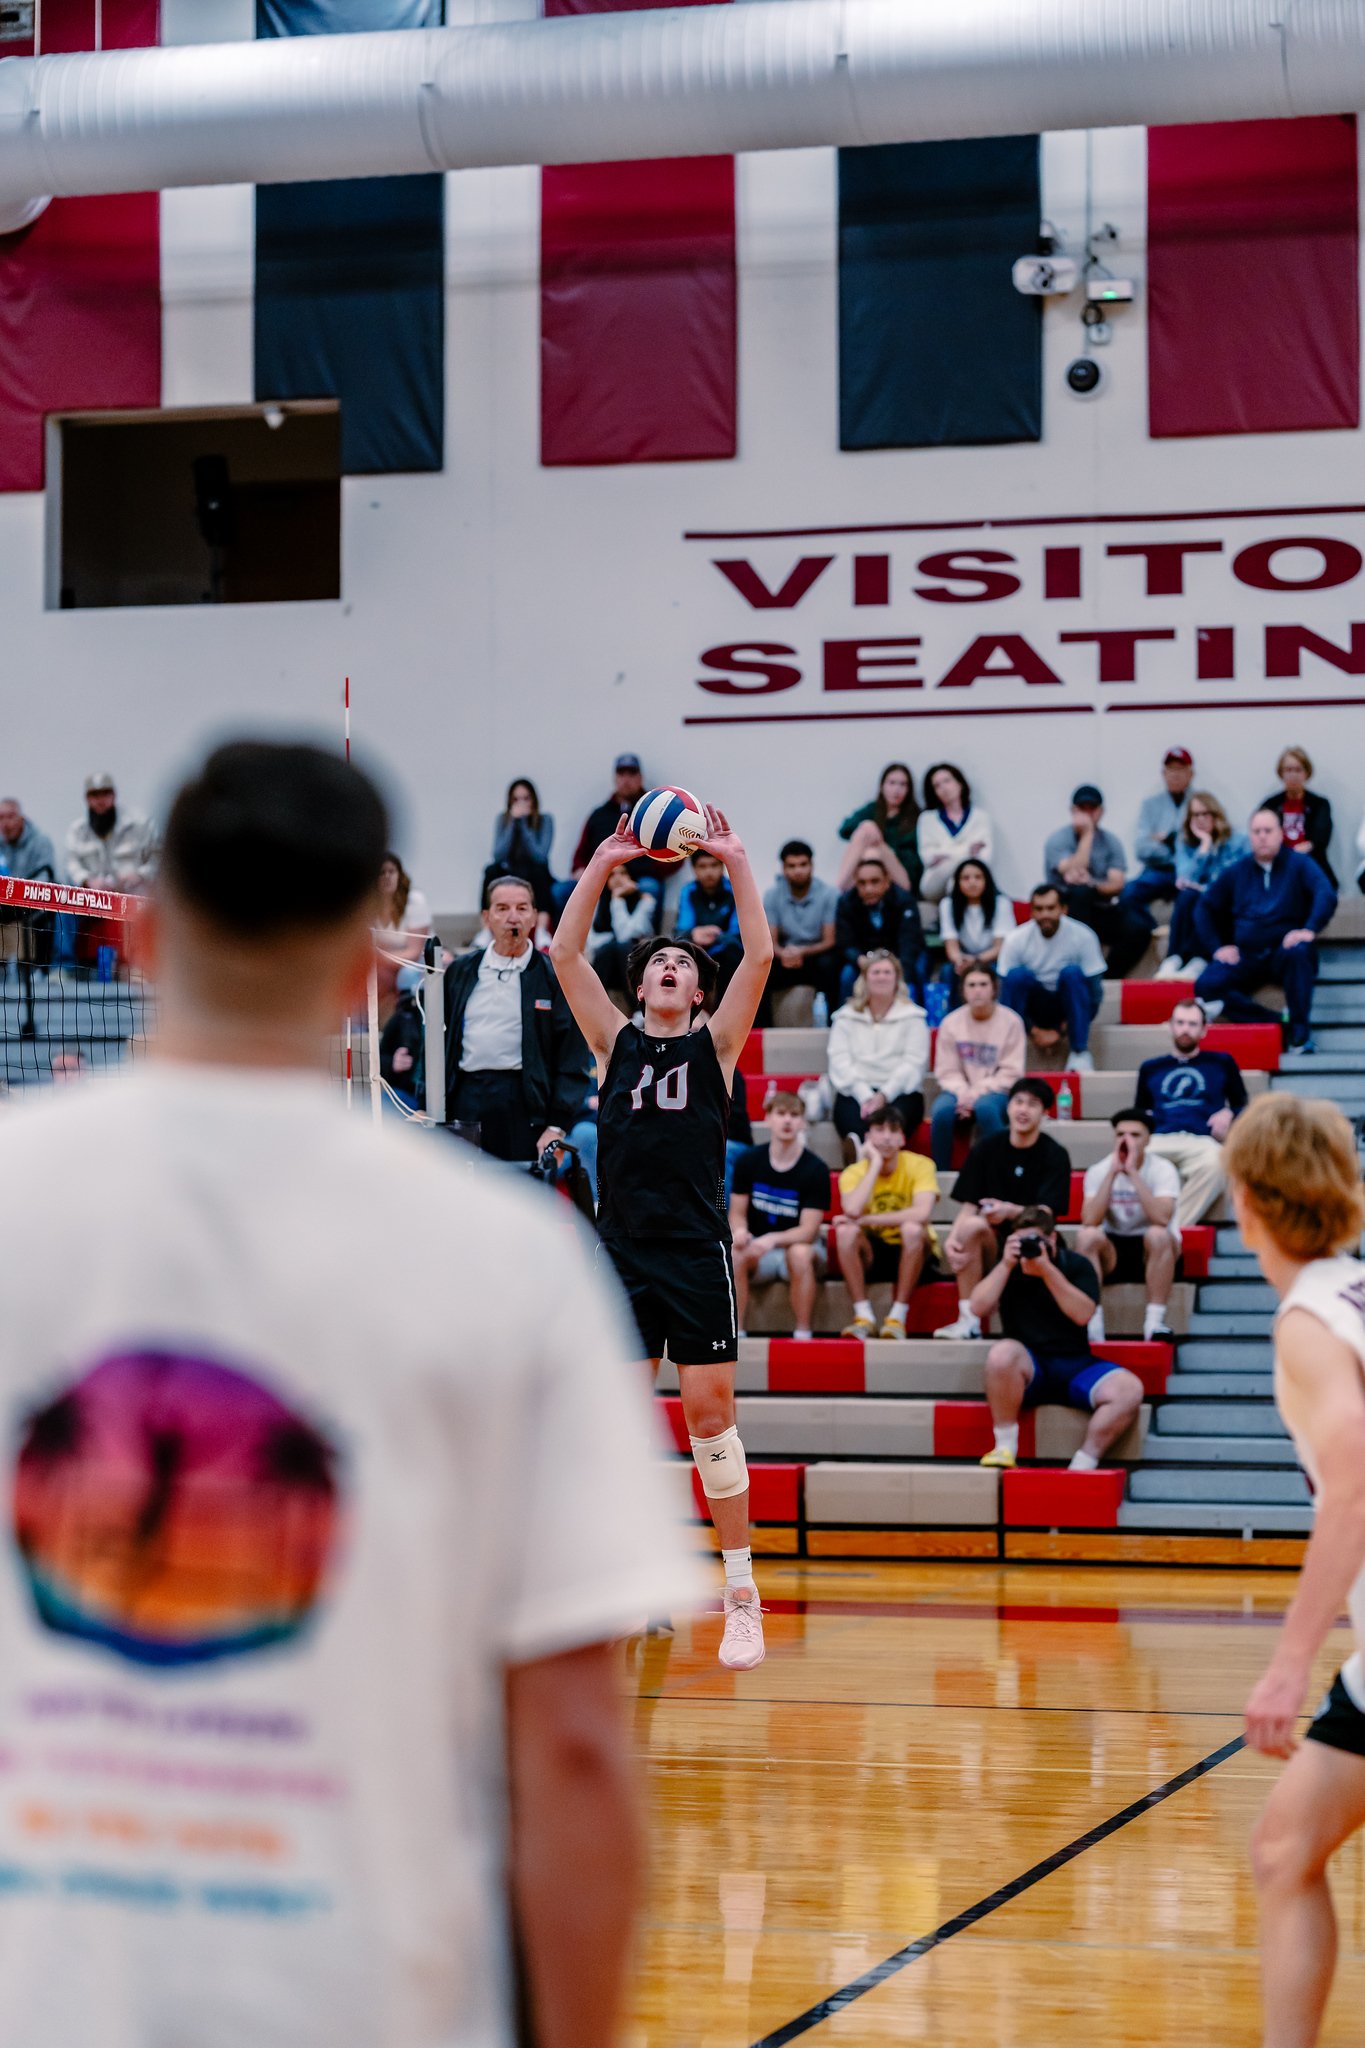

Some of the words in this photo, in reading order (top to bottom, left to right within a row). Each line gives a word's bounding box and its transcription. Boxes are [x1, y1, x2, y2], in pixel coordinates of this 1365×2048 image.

[712, 537, 1363, 608] VISITO
[696, 622, 1365, 695] SEATIN
[23, 885, 51, 902] PNHS
[54, 888, 113, 910] VOLLEYBALL
[631, 1061, 689, 1110] 10
